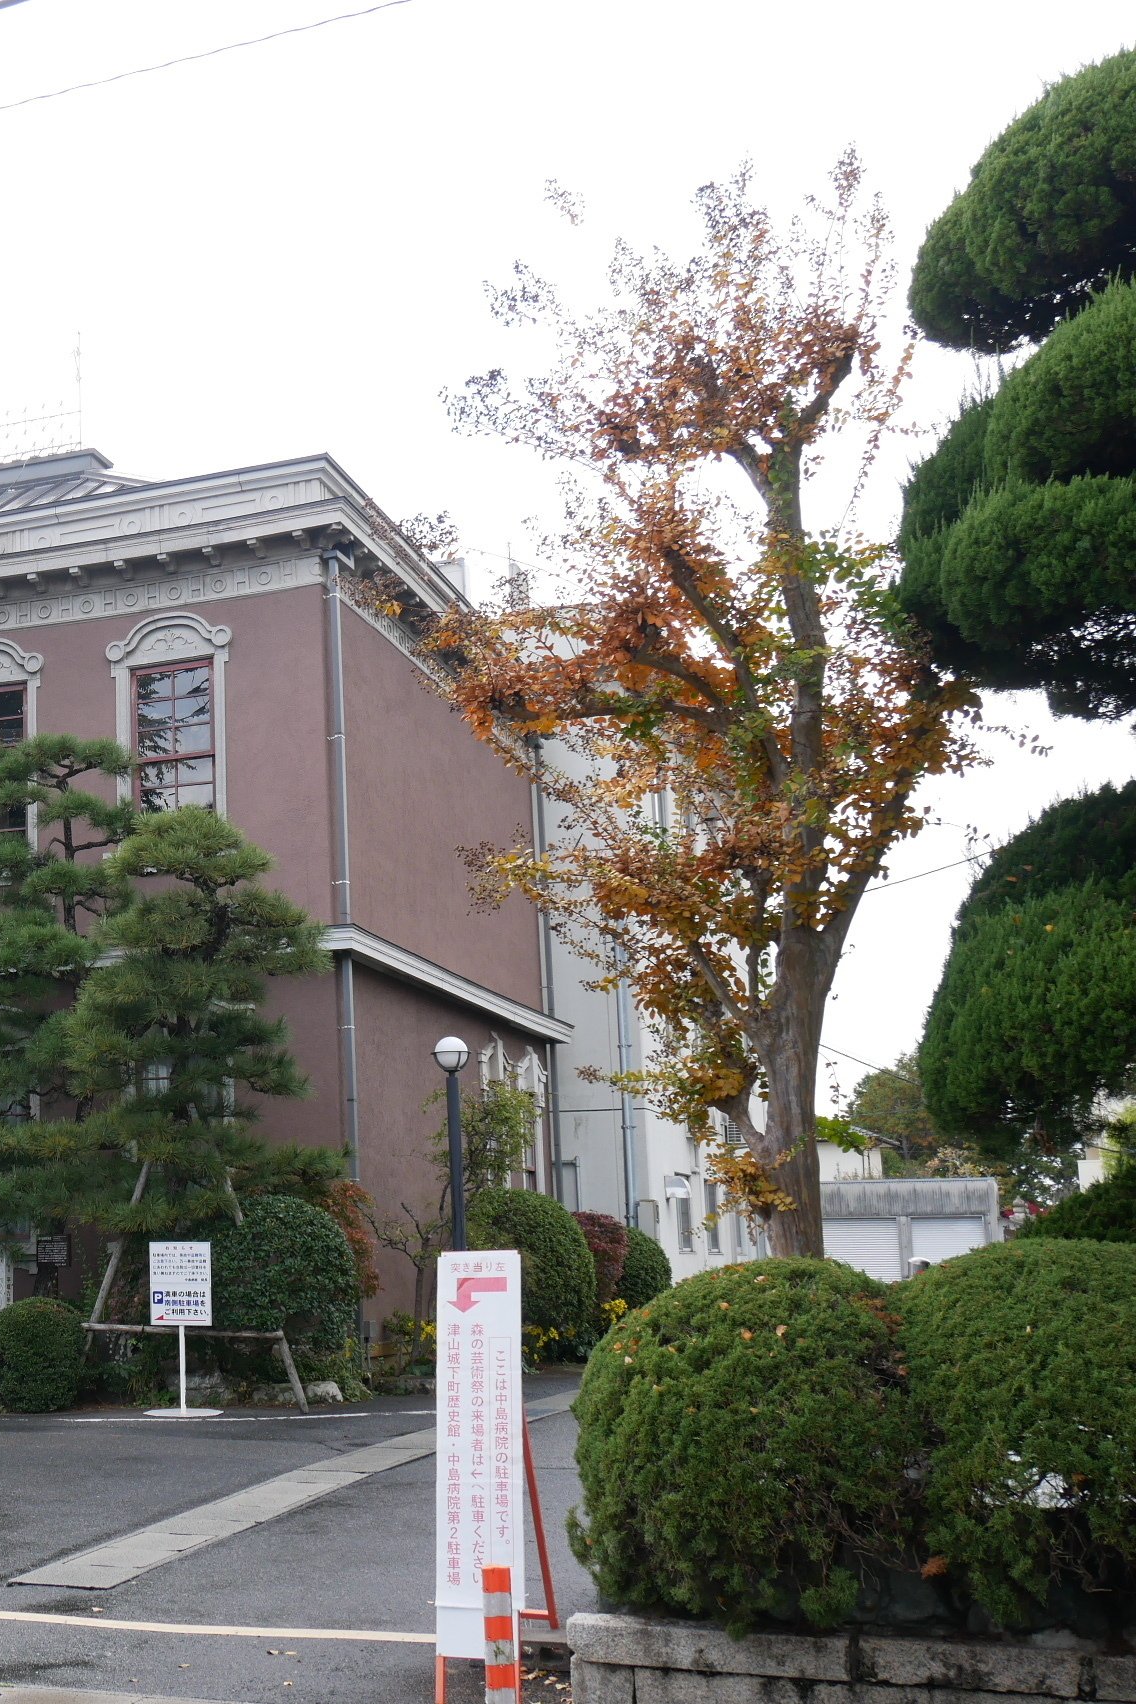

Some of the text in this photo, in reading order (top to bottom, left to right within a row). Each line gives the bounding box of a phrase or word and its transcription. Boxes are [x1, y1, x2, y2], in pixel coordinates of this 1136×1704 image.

[450, 1261, 506, 1274] 突き当り左
[495, 1350, 511, 1546] ここは中島病院の駐車場です。
